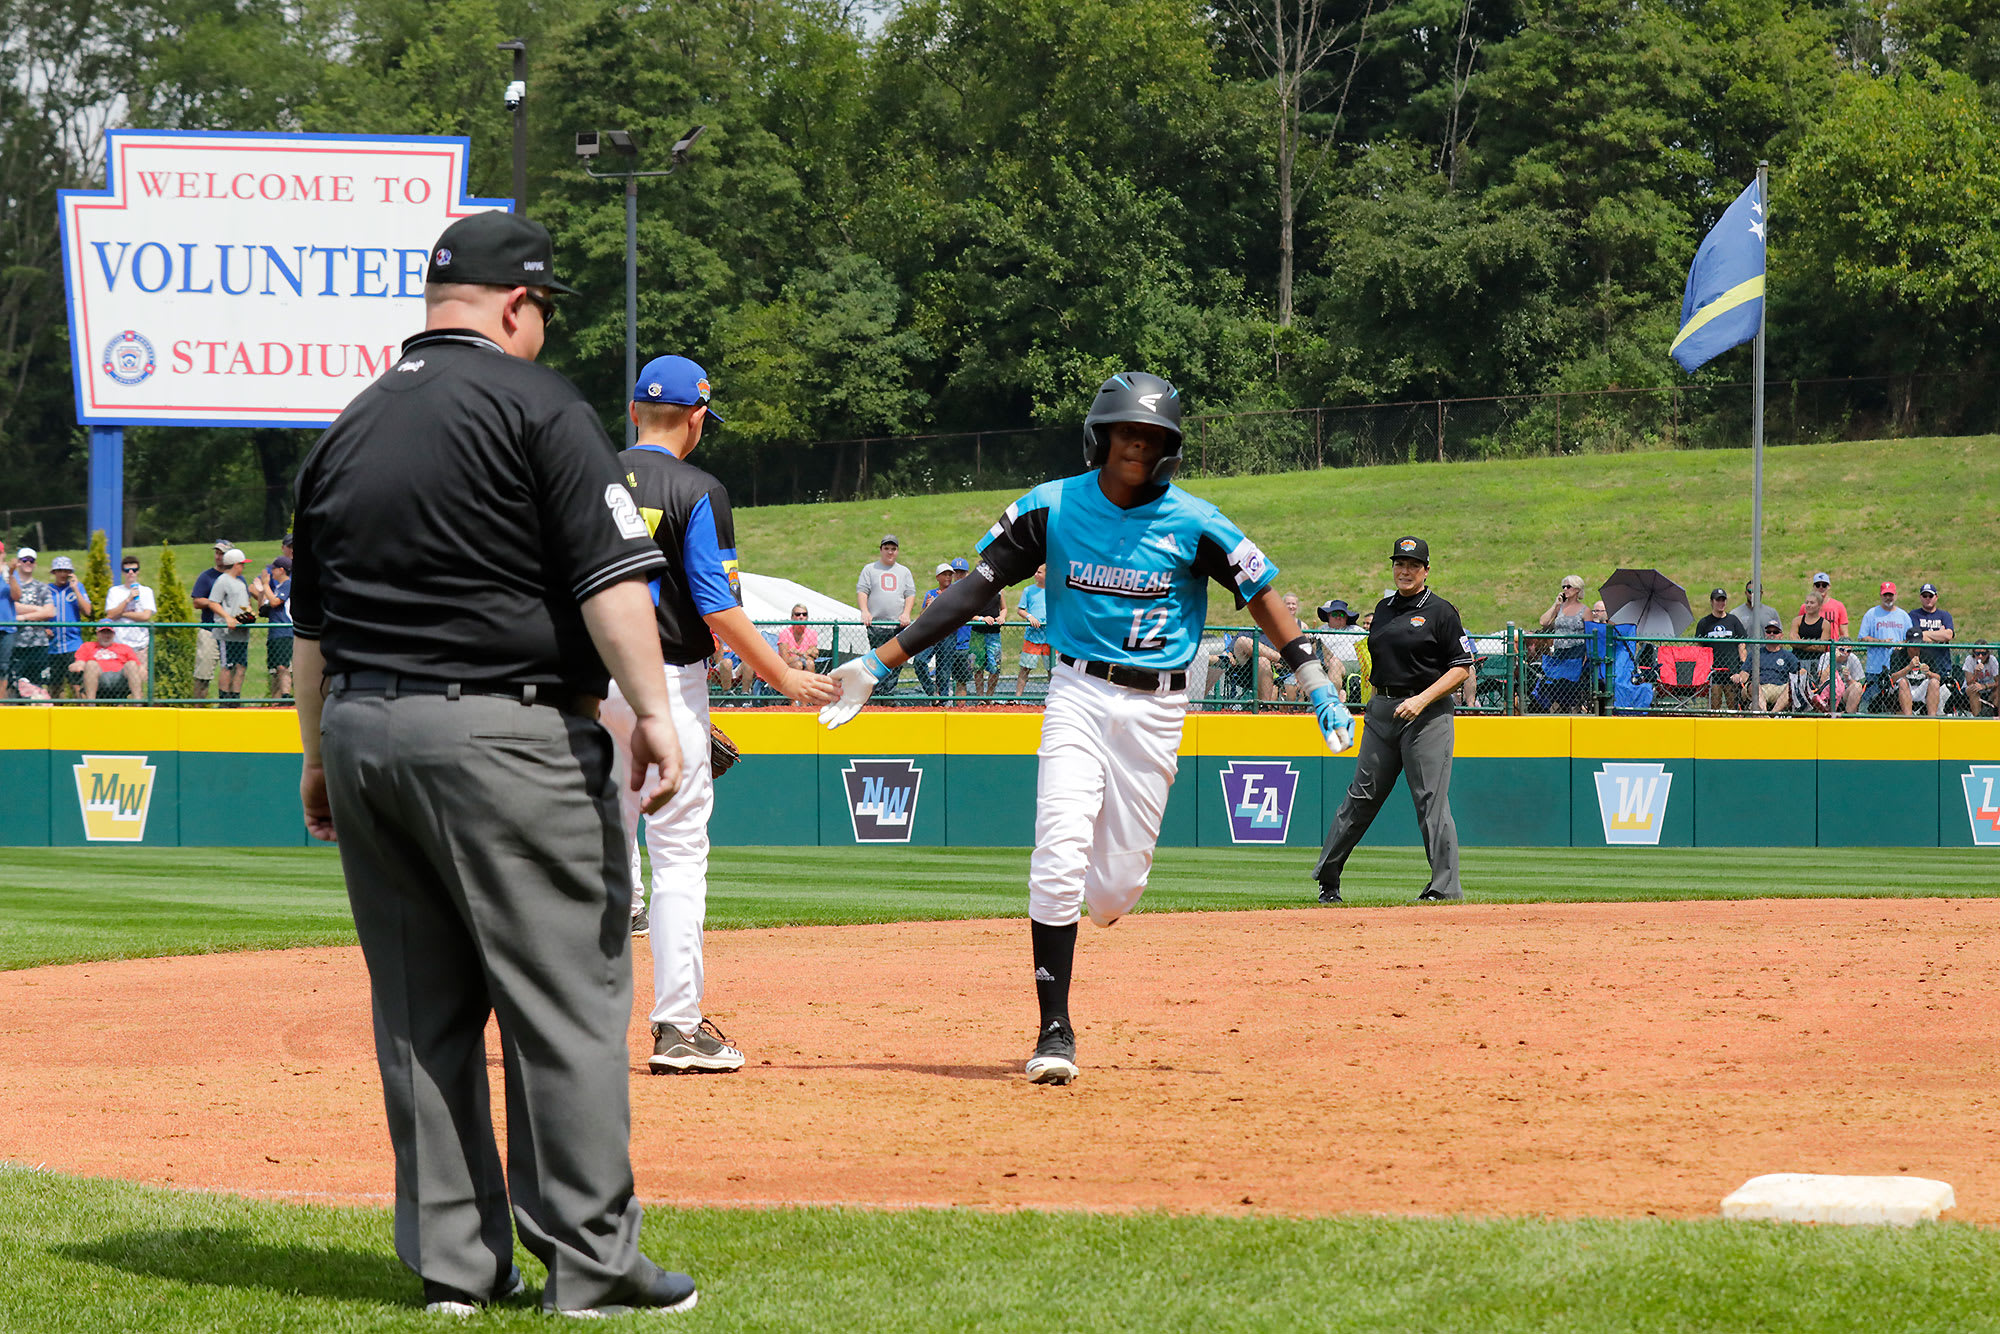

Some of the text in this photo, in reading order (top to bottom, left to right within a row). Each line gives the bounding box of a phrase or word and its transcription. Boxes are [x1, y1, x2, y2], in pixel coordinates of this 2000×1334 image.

[137, 171, 431, 204] WELCOME TO
[90, 241, 430, 299] VOLUNTEE
[172, 340, 396, 378] STADIUM
[604, 483, 649, 540] 2
[879, 571, 898, 593] O
[1068, 560, 1174, 593] CARIBBEAN
[1127, 606, 1168, 648] 12
[90, 773, 146, 816] MW
[861, 776, 911, 820] NW
[1240, 773, 1279, 823] EA
[1615, 776, 1659, 823] W
[1981, 777, 2000, 826] L
